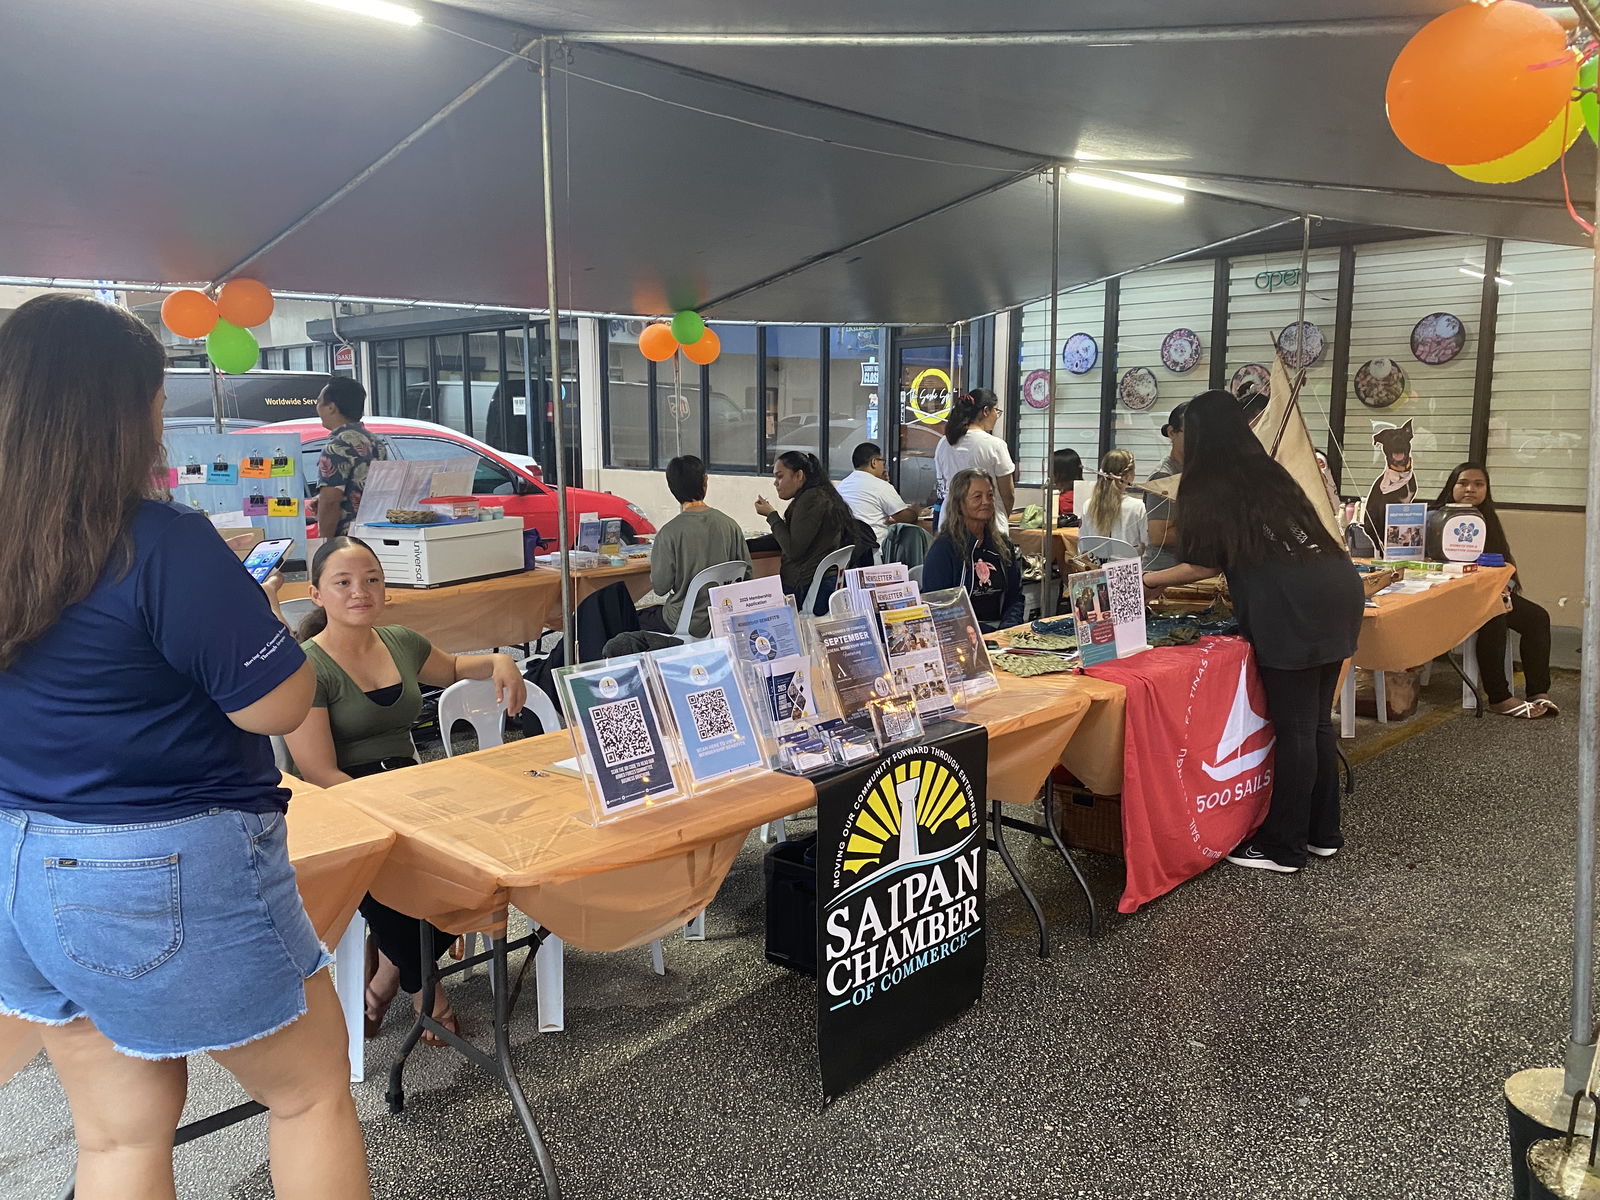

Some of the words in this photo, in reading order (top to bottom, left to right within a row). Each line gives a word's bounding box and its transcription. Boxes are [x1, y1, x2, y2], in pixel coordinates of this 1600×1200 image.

[264, 398, 302, 406] Worldwide
[413, 541, 424, 582] universal
[865, 574, 892, 582] NEWSLETTER
[877, 592, 904, 600] NEWSLETTER
[823, 631, 870, 647] SEPTEMBER
[1196, 788, 1231, 813] 500
[1234, 768, 1271, 802] SAILS
[833, 841, 846, 888] MOVING
[842, 812, 856, 837] OUR
[854, 757, 891, 810] COMMUNITY
[892, 746, 929, 762] FORWARD
[930, 746, 960, 771] THROUGH
[958, 769, 978, 826] ENTERPRISE
[1189, 817, 1201, 843] SAIL
[826, 846, 981, 962] SAIPAN
[826, 895, 981, 997] CHAMBER
[852, 981, 875, 1006] OF
[880, 931, 968, 992] COMMERCE
